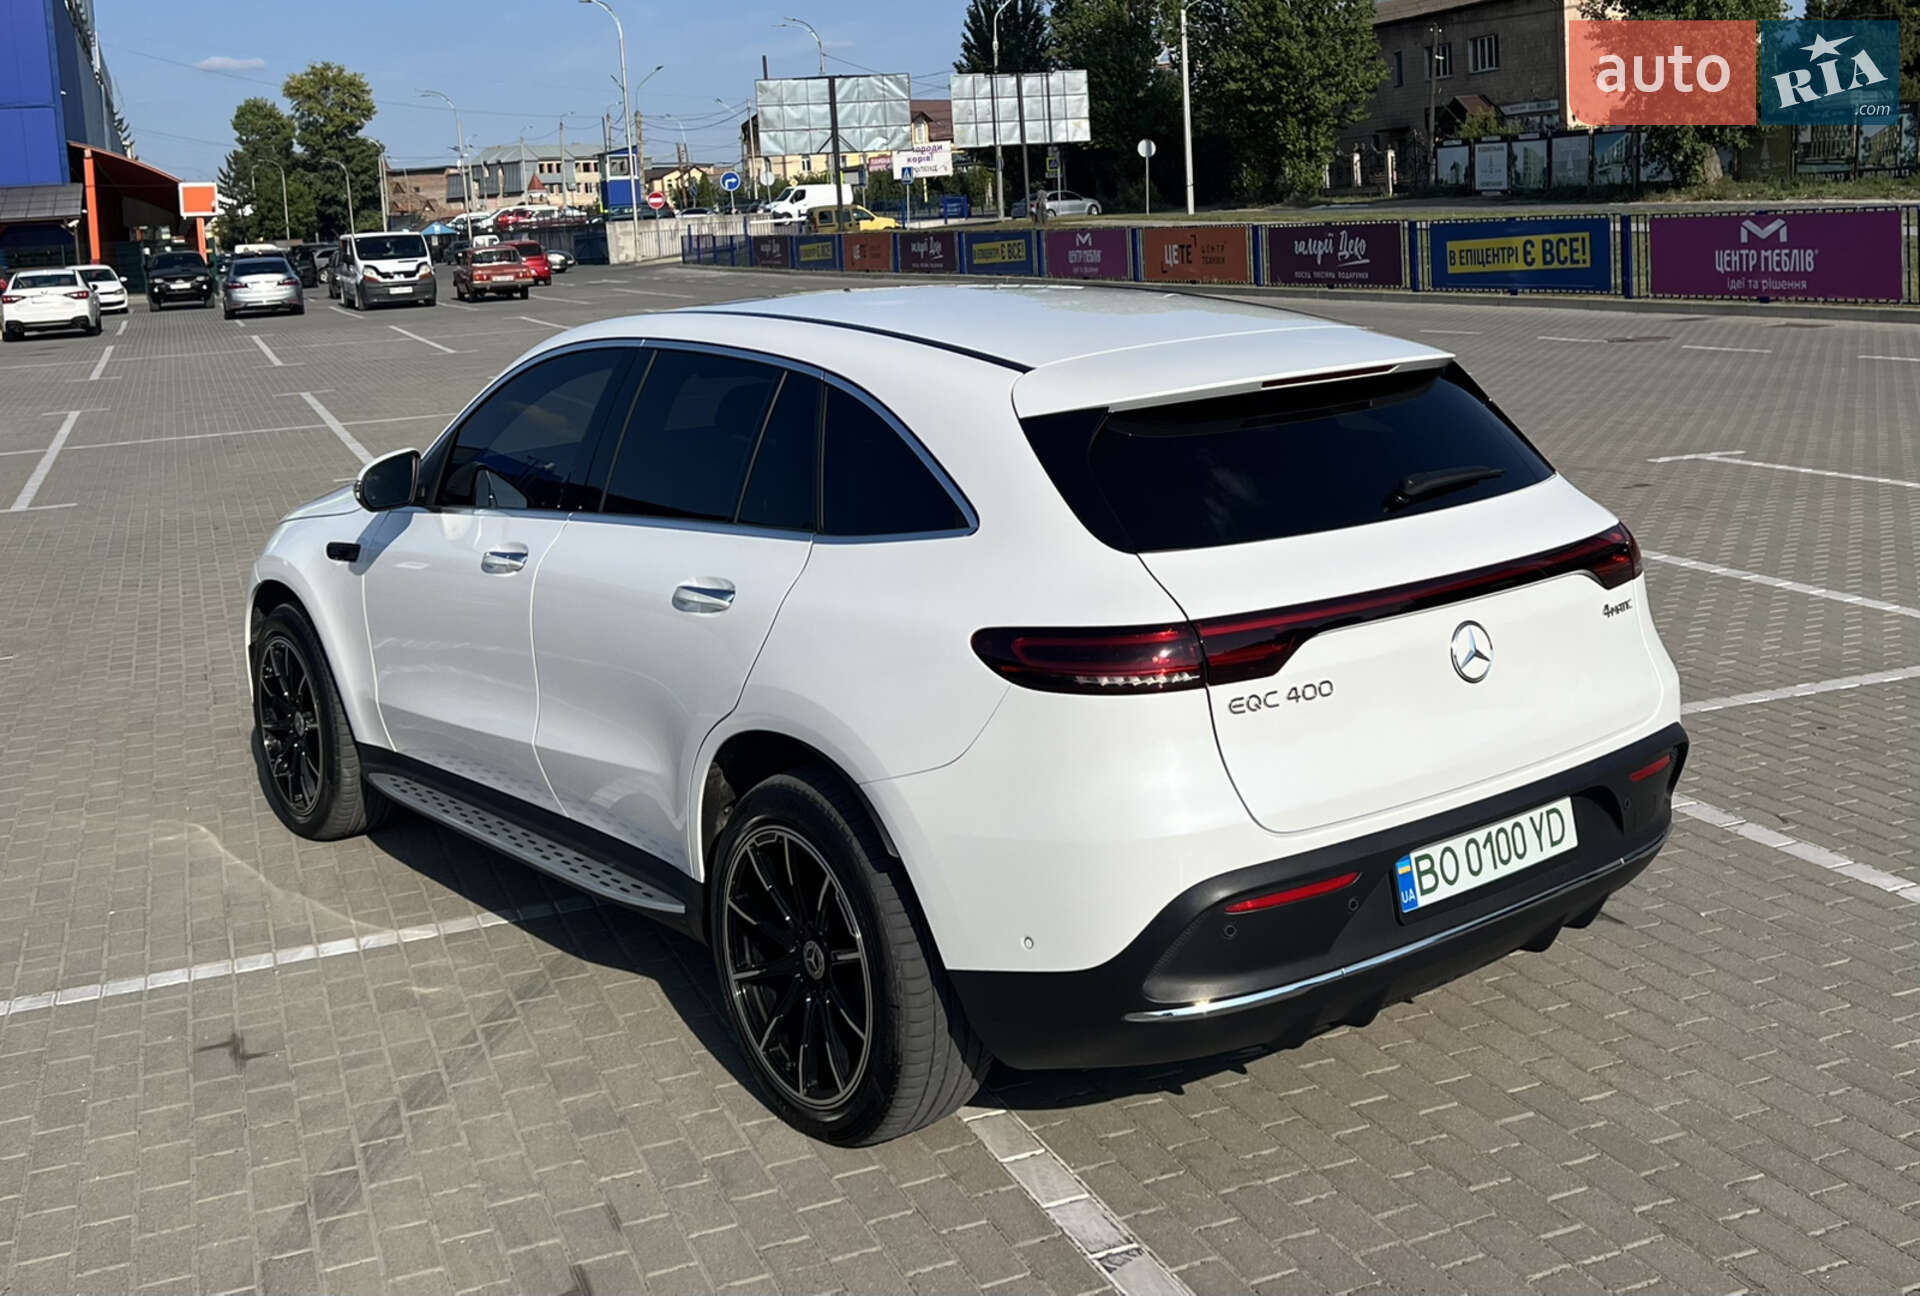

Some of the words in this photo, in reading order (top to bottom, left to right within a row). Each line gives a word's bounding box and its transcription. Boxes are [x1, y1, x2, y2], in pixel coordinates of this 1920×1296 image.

[1449, 249, 1457, 267] В
[1459, 246, 1519, 268] ЕПІЦЕНТРІ
[1523, 239, 1536, 267] Є
[1541, 237, 1587, 267] ВСЕ!
[1715, 249, 1757, 274] ЦЕНТР
[1761, 249, 1815, 272] МЕБЛІВ
[1229, 690, 1279, 714] EQC
[1287, 680, 1333, 702] 400
[1414, 846, 1460, 896] BO
[1465, 821, 1527, 877] 0100
[1530, 807, 1565, 852] YD
[1401, 888, 1416, 903] UA
